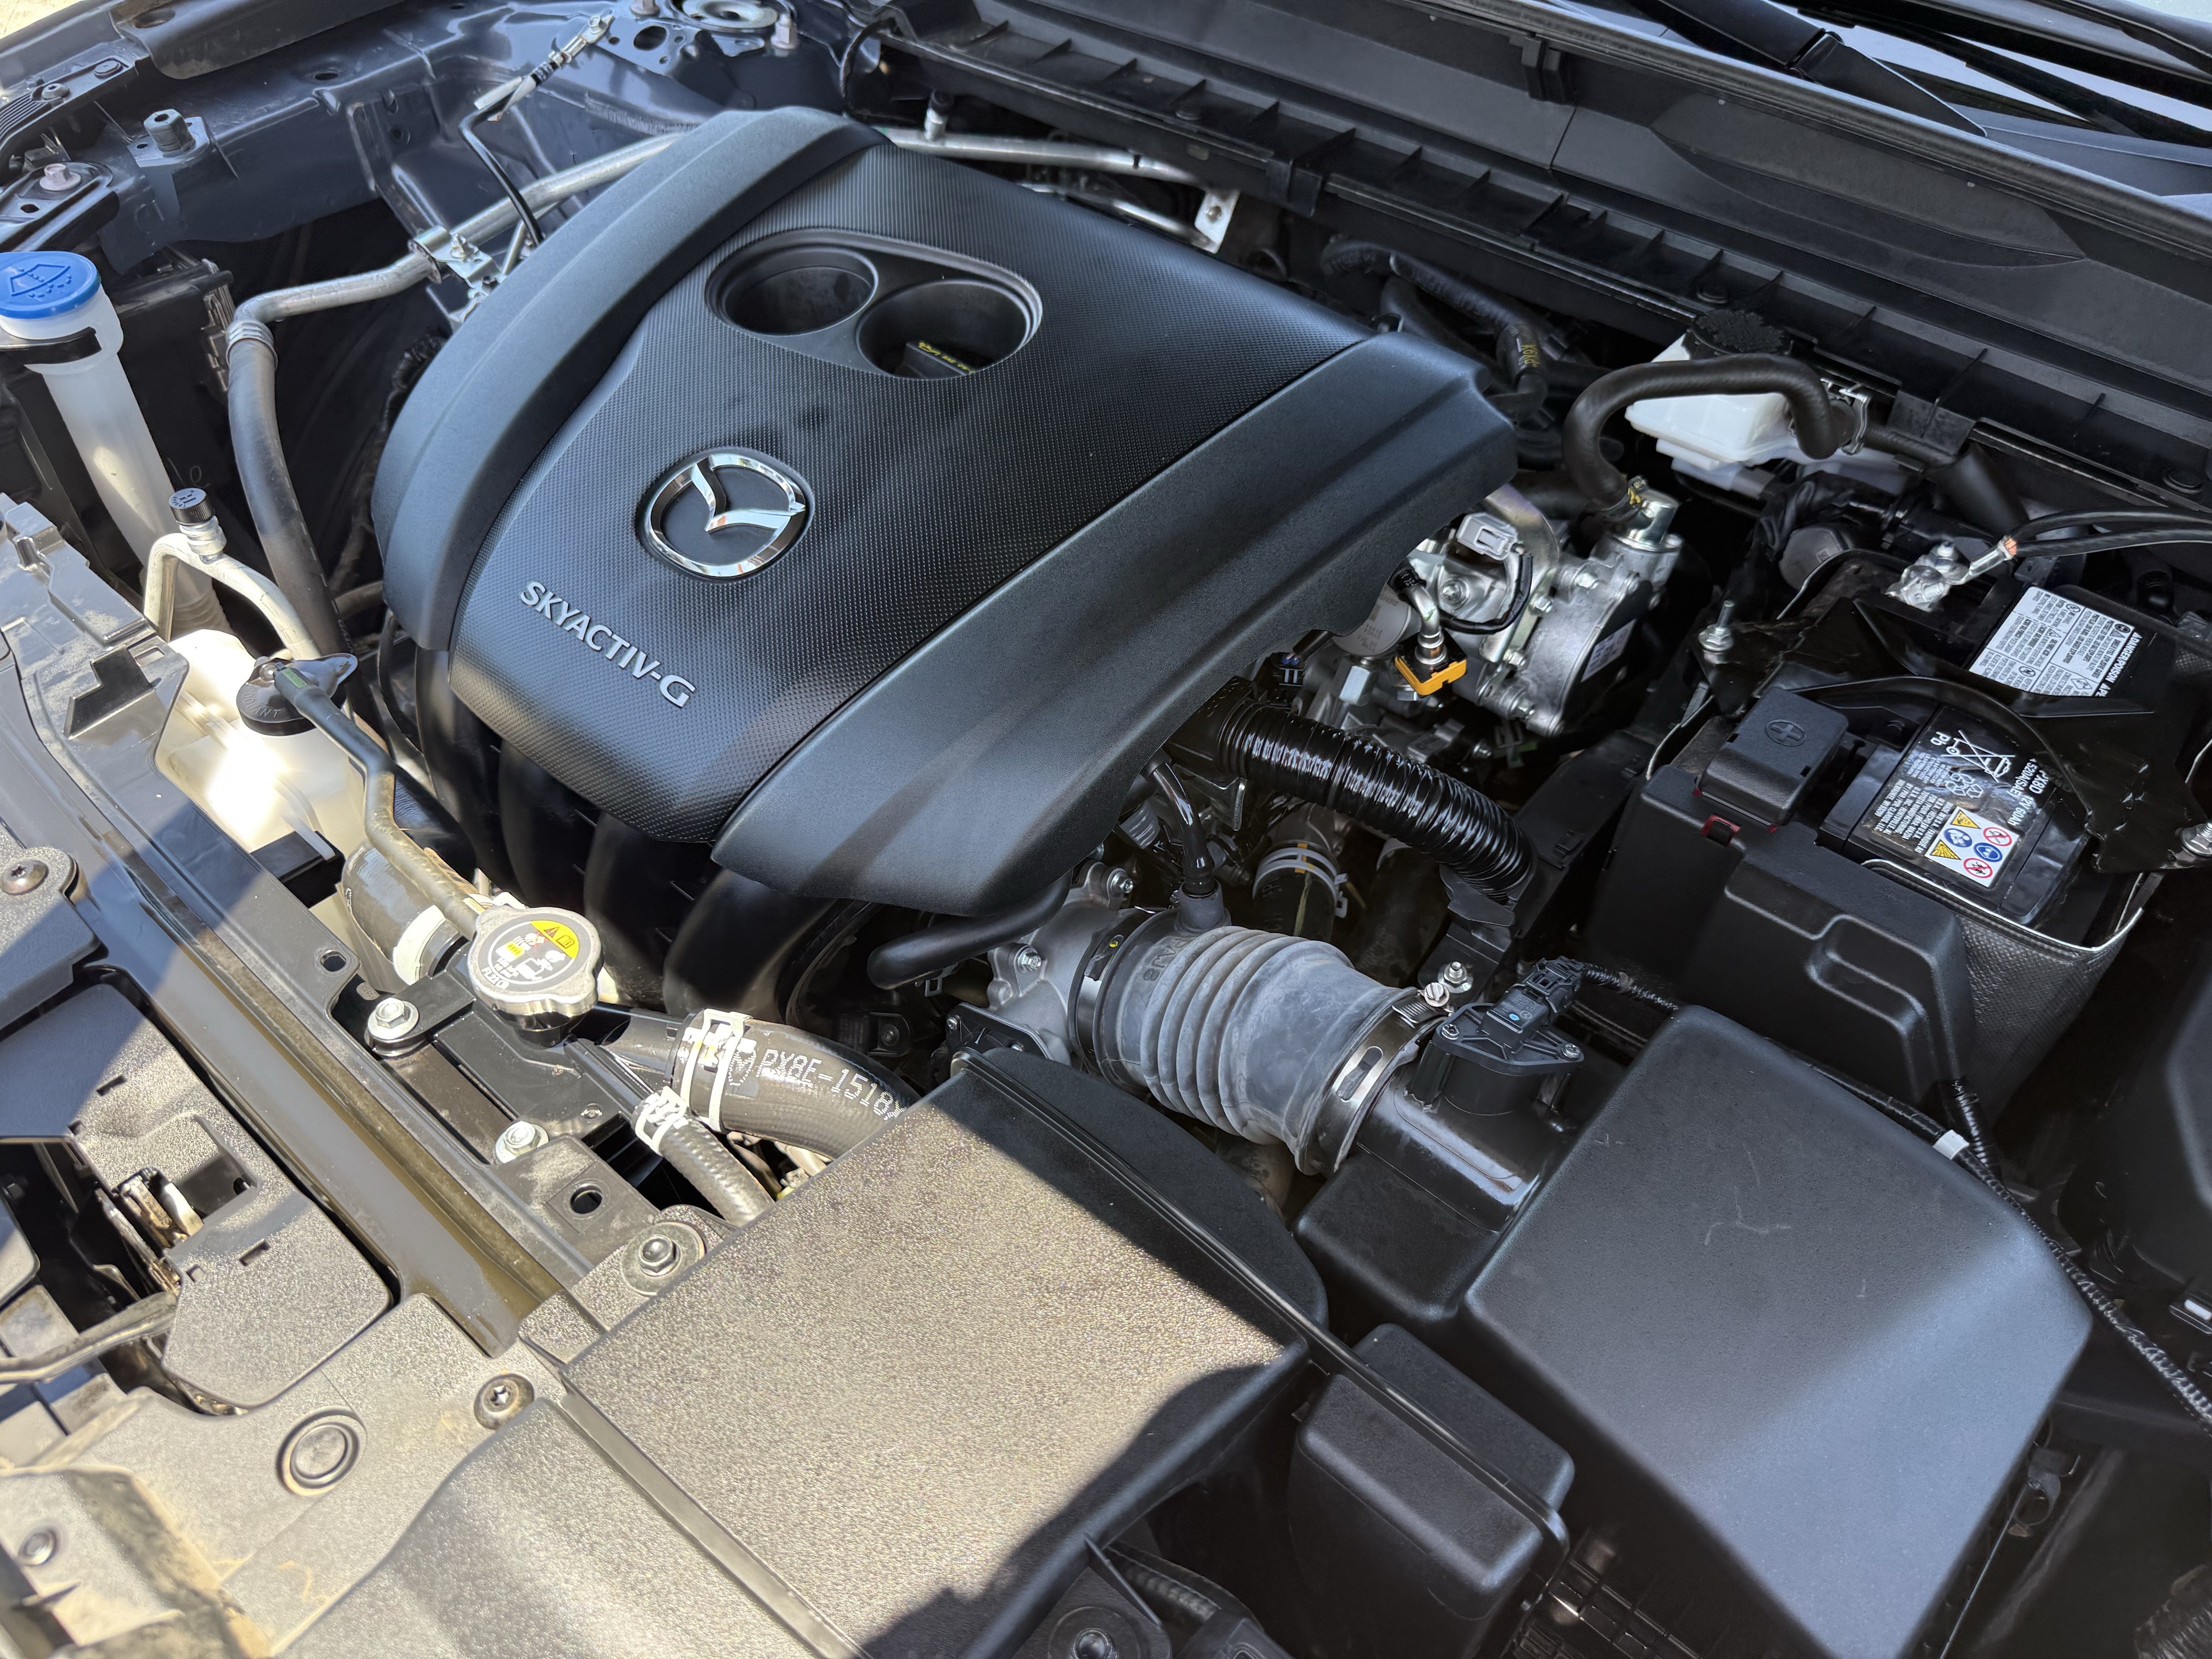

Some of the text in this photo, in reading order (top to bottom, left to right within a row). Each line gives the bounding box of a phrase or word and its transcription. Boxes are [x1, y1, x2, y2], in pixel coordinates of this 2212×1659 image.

[521, 581, 696, 708] SKYACTIV-G
[1930, 731, 1951, 745] Pb
[2006, 762, 2037, 798] 520A(SAE)
[2019, 795, 2033, 809] 12V
[2007, 807, 2026, 826] 60Ah
